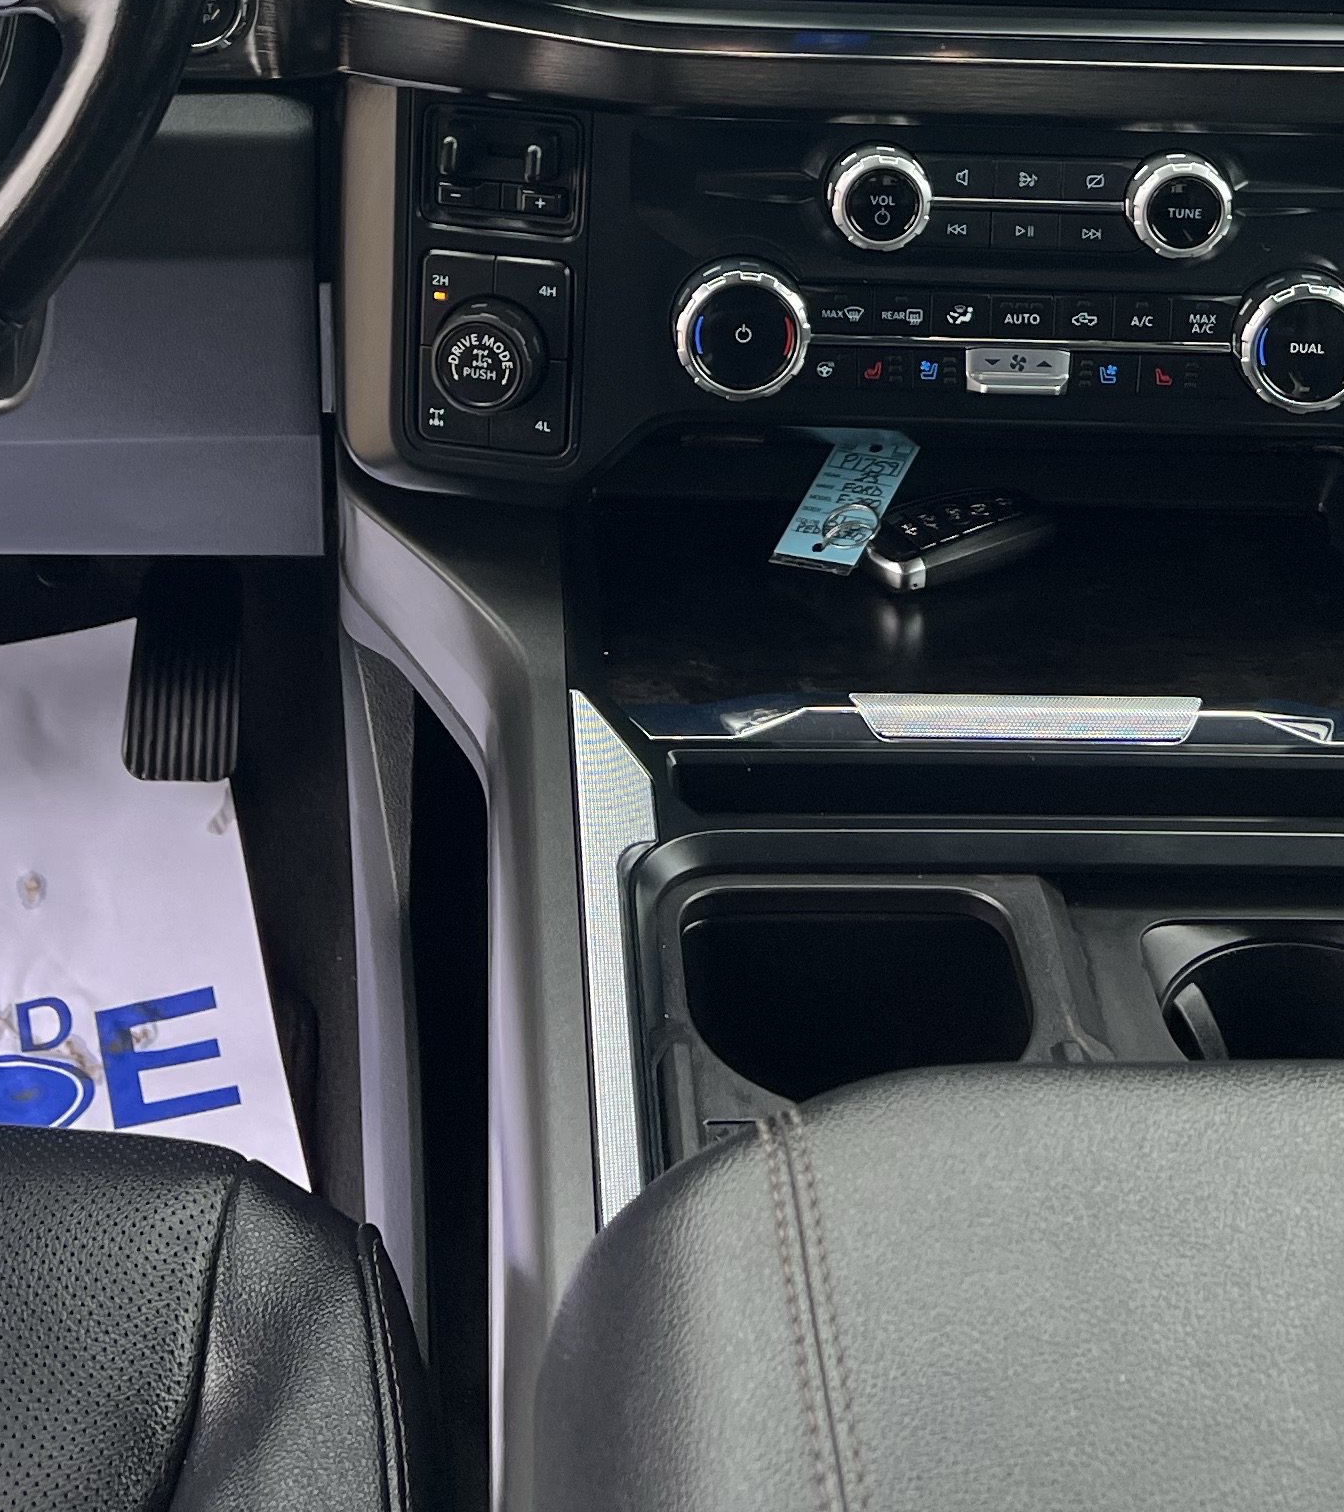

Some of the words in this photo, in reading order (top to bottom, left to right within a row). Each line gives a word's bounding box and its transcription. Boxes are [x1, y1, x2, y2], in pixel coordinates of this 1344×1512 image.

[870, 195, 896, 207] VOL
[1167, 208, 1203, 220] TUNE
[432, 274, 449, 286] 2H
[538, 286, 557, 297] 4H
[821, 308, 844, 320] MAX
[881, 310, 905, 321] REAR
[1004, 313, 1040, 326] AUTO
[1189, 314, 1217, 325] MAX
[1130, 314, 1154, 328] A/C
[1192, 322, 1215, 335] A/C
[448, 333, 479, 364] DRIVE
[481, 335, 514, 370] MODE
[1289, 342, 1325, 355] DUAL
[463, 367, 496, 381] PUSH
[535, 421, 551, 432] 4L
[841, 482, 884, 497] FORD
